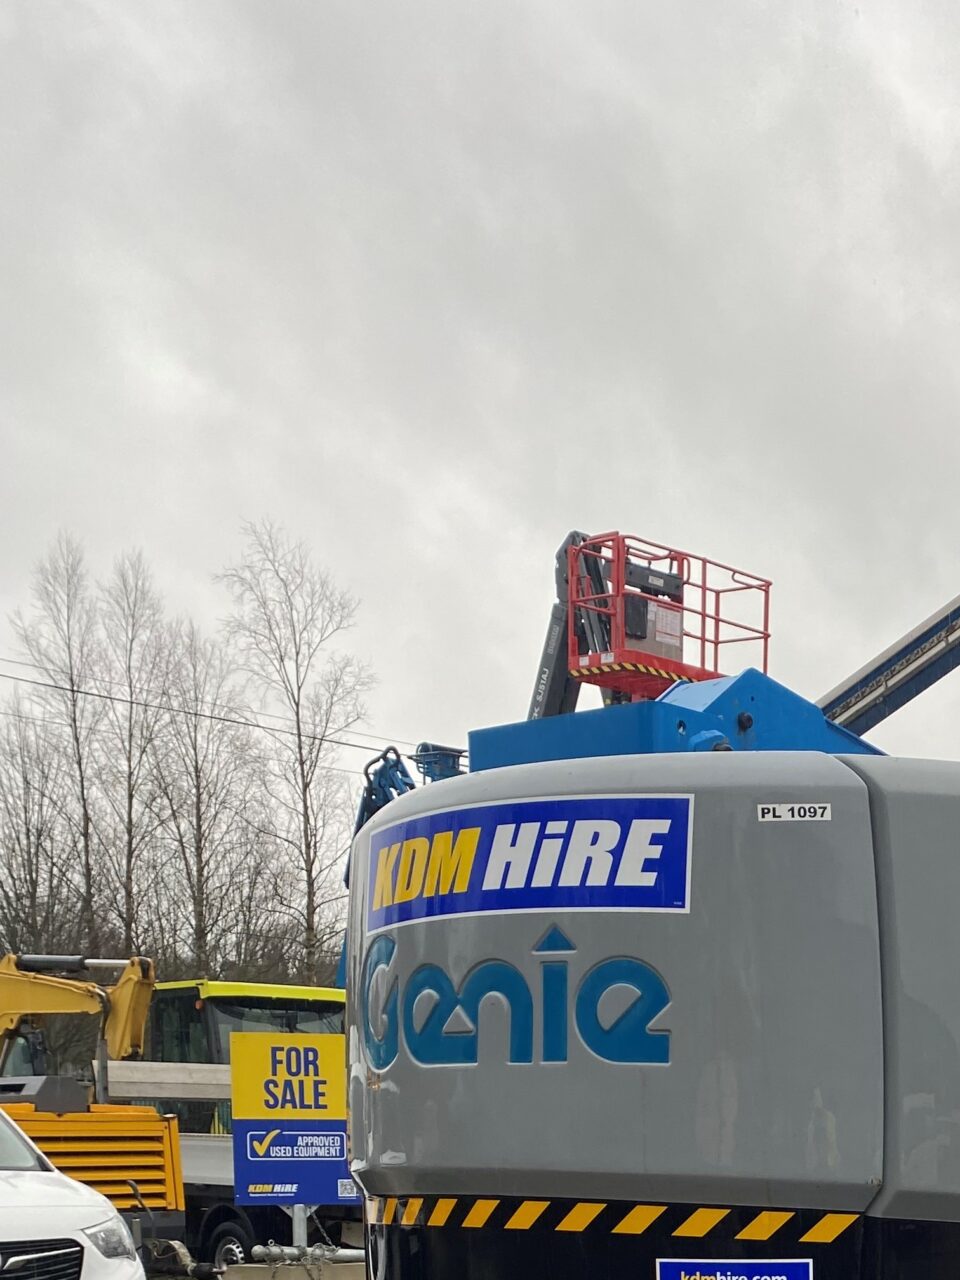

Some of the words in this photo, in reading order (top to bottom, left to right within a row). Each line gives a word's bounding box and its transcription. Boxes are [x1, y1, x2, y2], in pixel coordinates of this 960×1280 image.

[761, 807, 782, 819] PL
[788, 806, 828, 818] 1097
[371, 827, 482, 912] KDM
[481, 818, 672, 891] HiRE
[359, 923, 673, 1072] Genie
[270, 1046, 320, 1077] FOR
[263, 1079, 328, 1110] SALE
[270, 1147, 292, 1157] USED
[294, 1146, 341, 1157] EQUIPMENT
[297, 1136, 341, 1146] APPROVED
